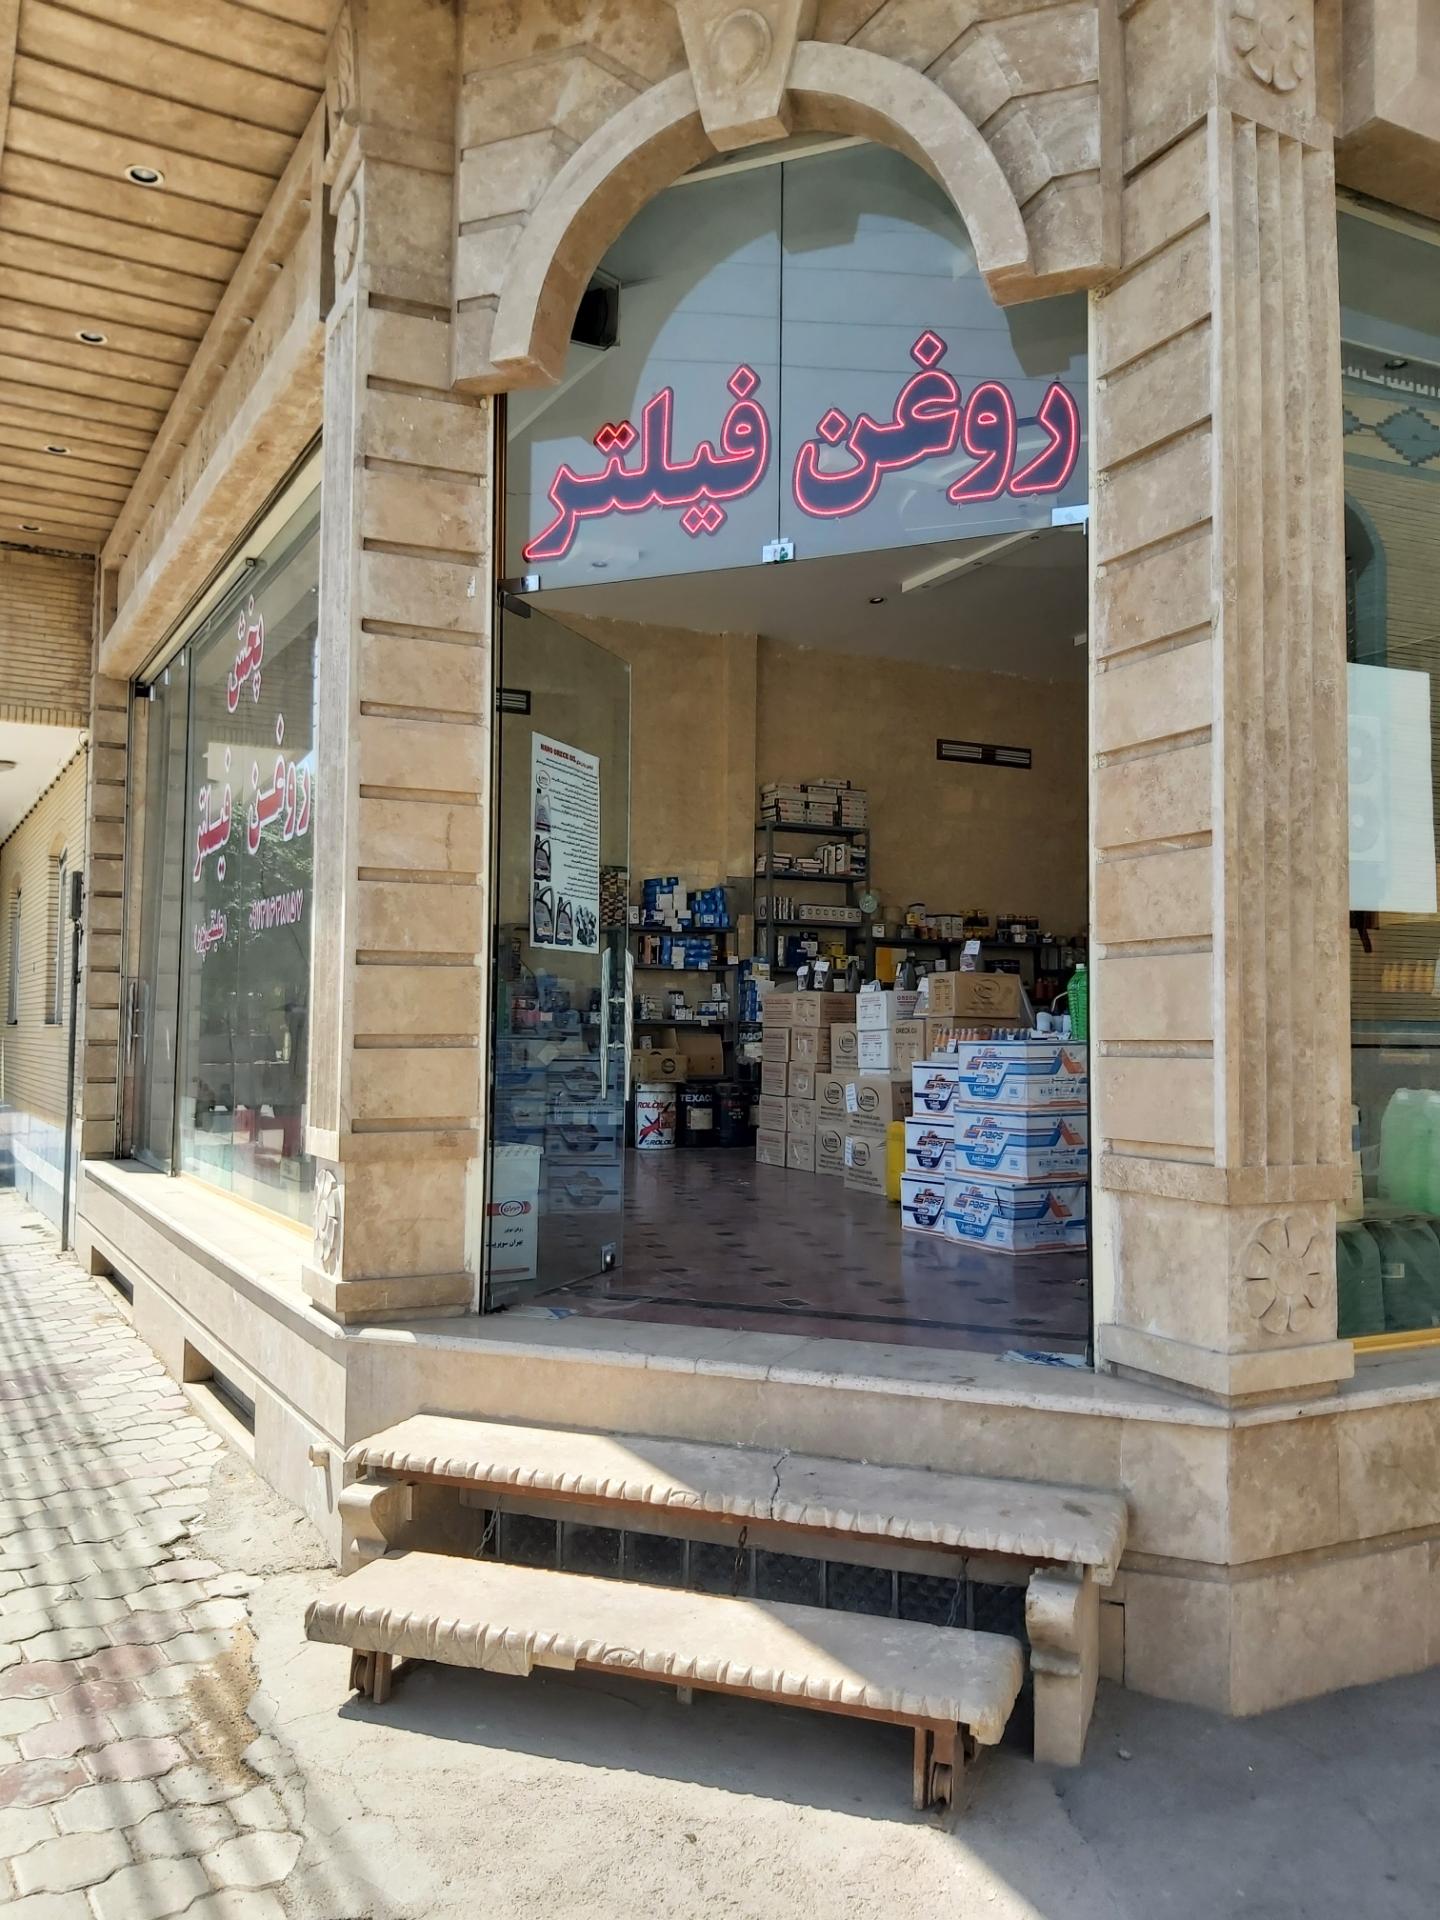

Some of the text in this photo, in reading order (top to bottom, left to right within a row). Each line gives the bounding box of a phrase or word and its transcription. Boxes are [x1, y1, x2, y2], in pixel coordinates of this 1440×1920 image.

[522, 330, 1080, 562] روغن فیلتر
[227, 594, 265, 713] پخش
[193, 712, 311, 882] روغن فیلتر
